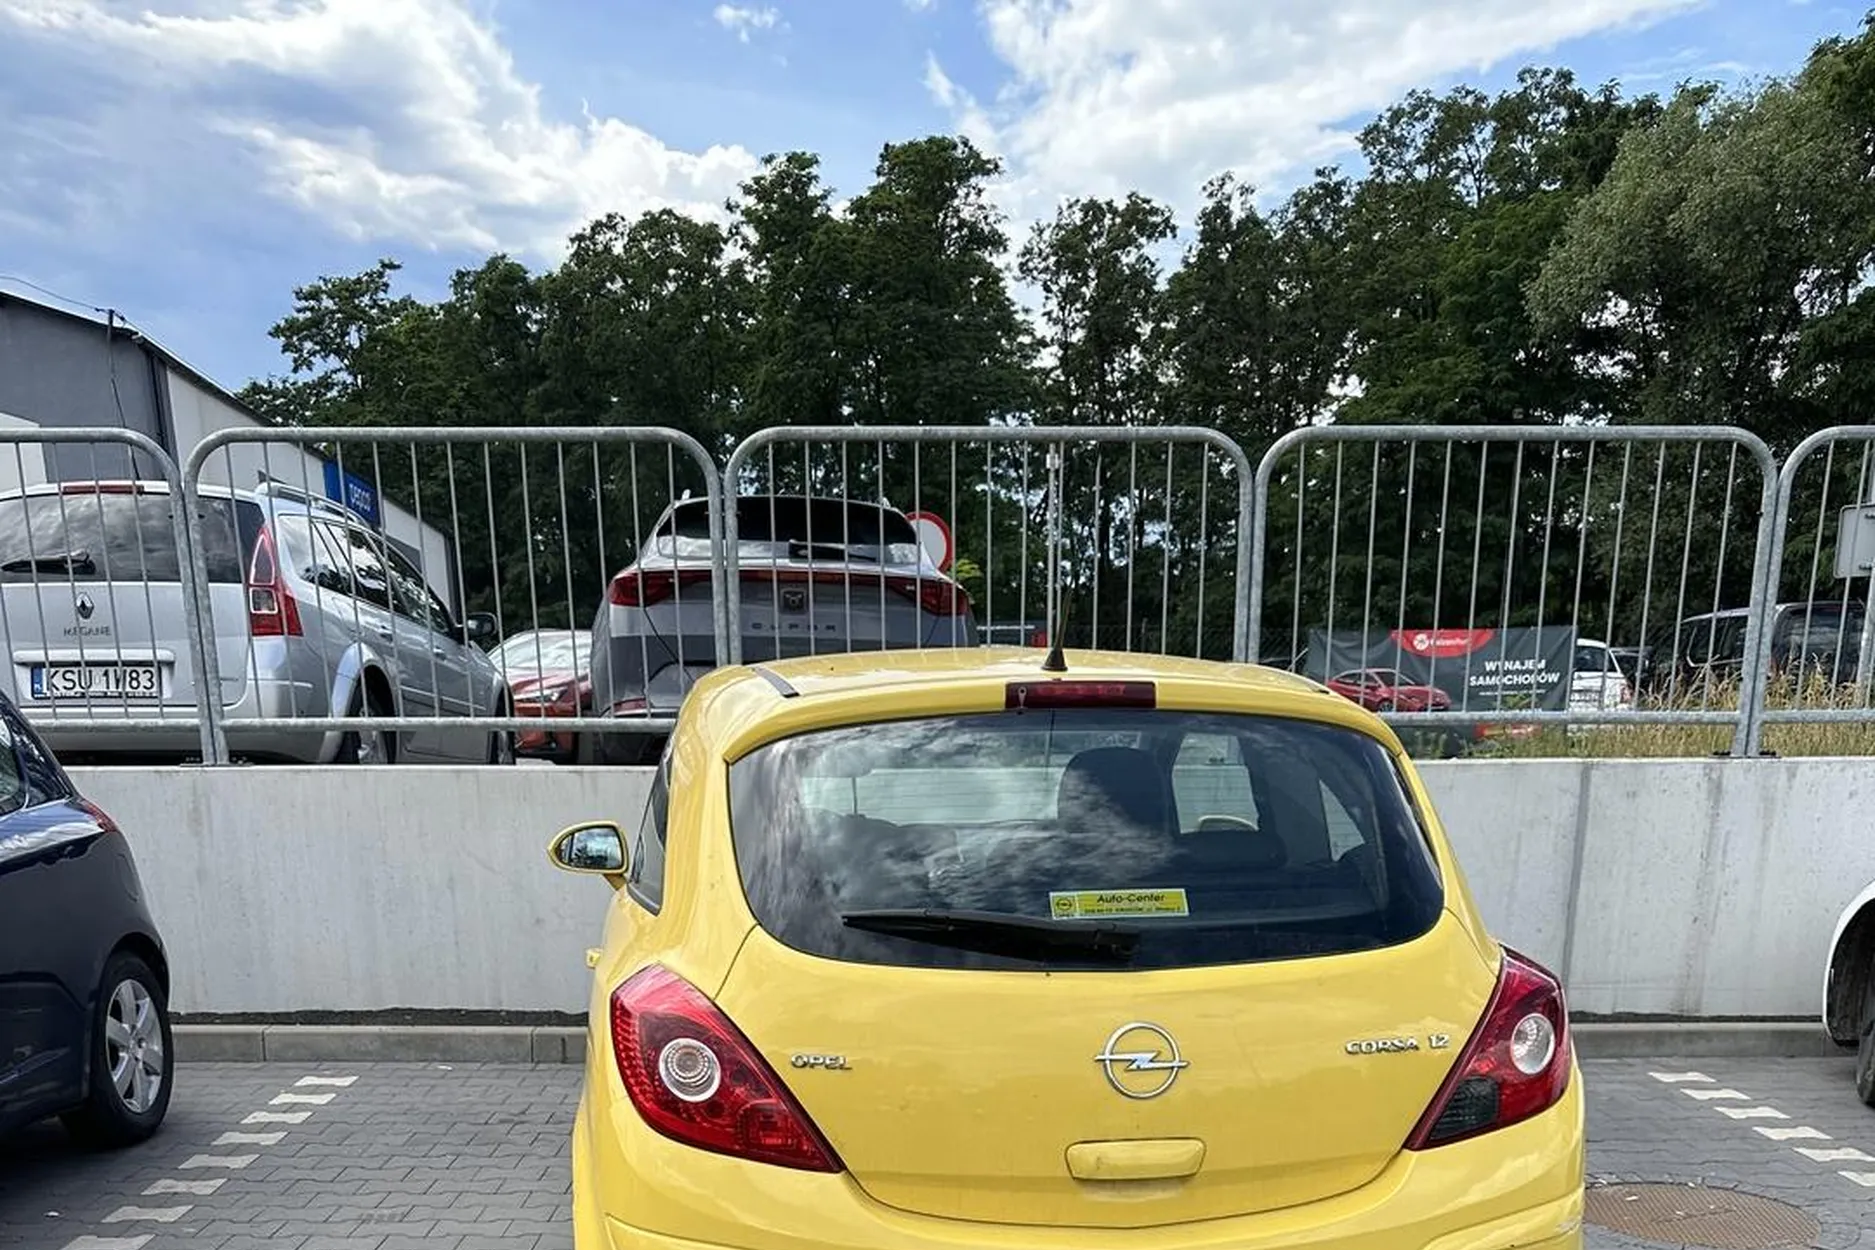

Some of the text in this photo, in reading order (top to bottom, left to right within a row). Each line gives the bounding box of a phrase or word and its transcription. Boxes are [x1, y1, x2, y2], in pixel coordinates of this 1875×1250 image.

[50, 669, 93, 692] KSU
[1097, 893, 1167, 904] Auto-Center
[1345, 1038, 1420, 1055] CORSA
[791, 1054, 853, 1070] OPEL
